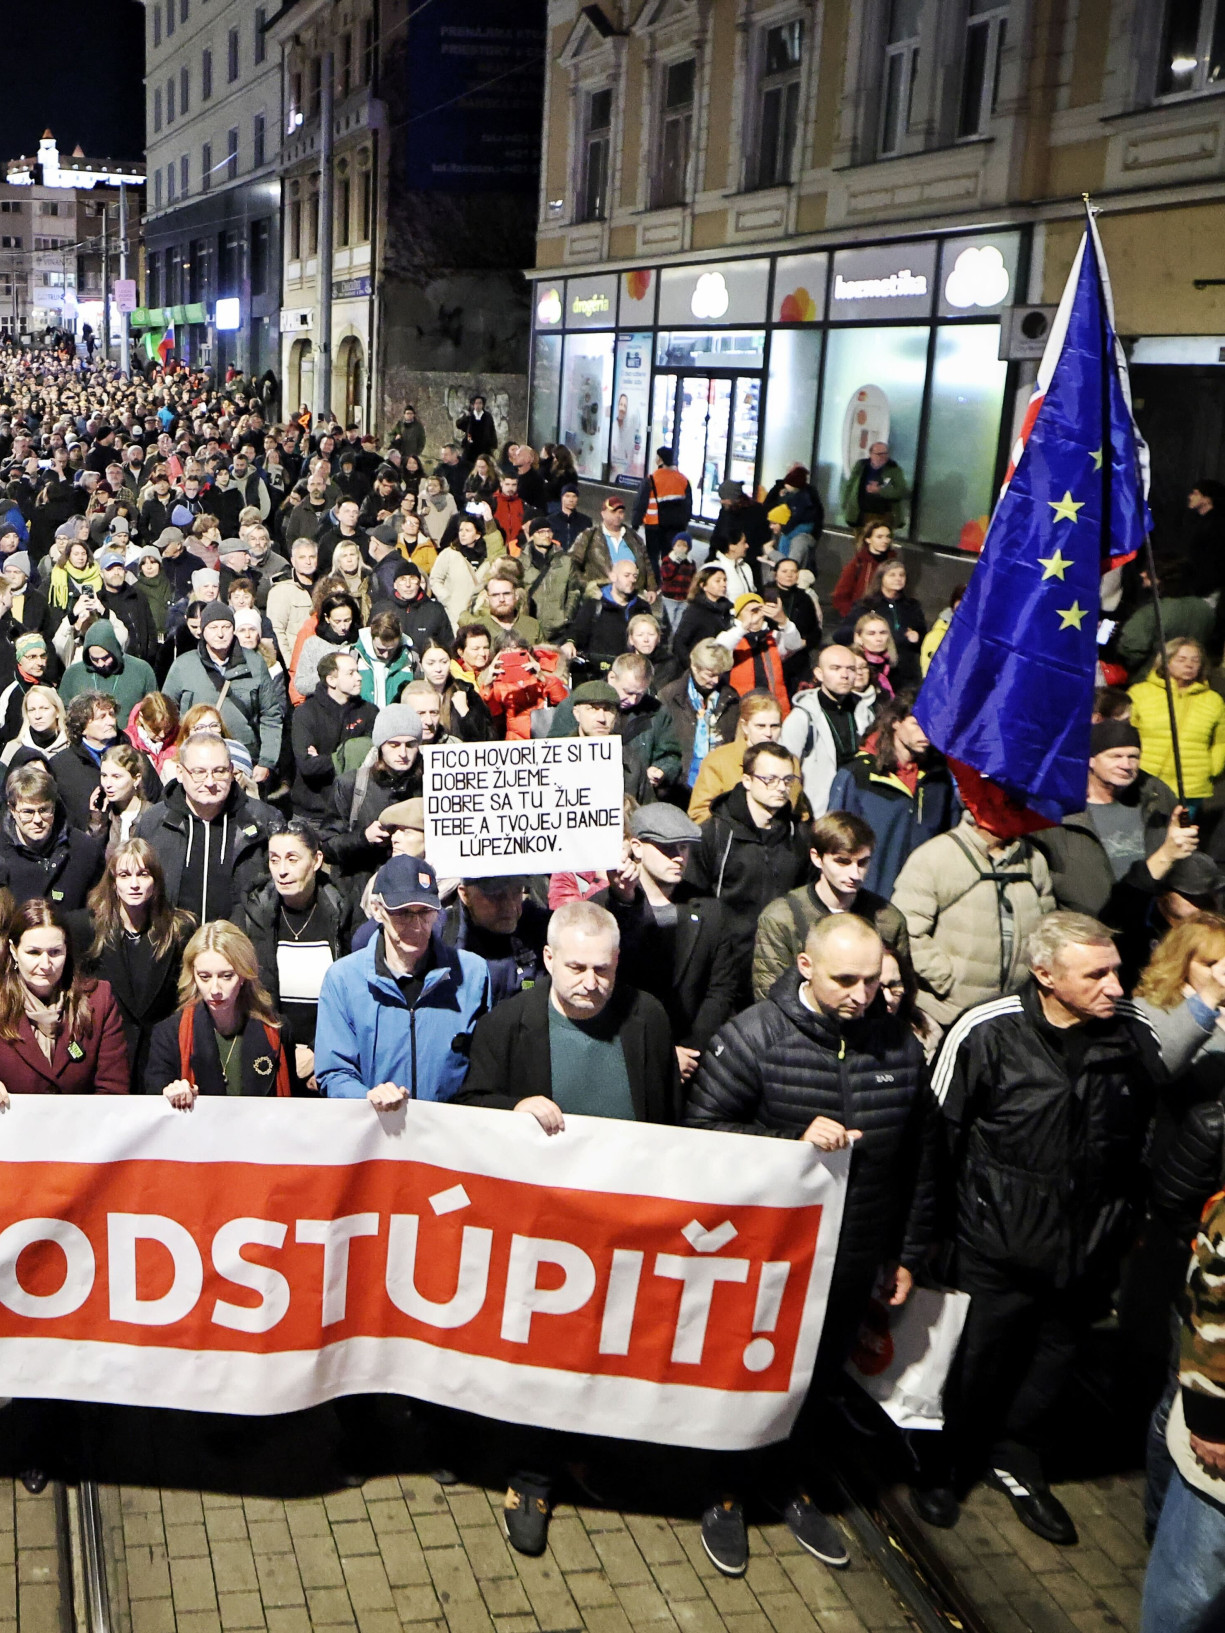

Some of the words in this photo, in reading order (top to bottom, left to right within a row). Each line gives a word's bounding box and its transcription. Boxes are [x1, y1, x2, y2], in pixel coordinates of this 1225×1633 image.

[835, 269, 927, 299] kozmetika
[572, 293, 610, 317] drogéria
[431, 750, 469, 769] FICO
[475, 742, 538, 768] HOVORÍ,
[542, 741, 562, 764] ŽE
[568, 744, 582, 763] SI
[588, 743, 611, 761] TU
[432, 771, 488, 791] DOBRE
[429, 793, 485, 814] DOBRE
[491, 792, 513, 811] SA
[518, 791, 543, 809] TU
[555, 785, 591, 808] ŽIJE
[480, 816, 490, 834] A
[497, 813, 561, 833] TVOJEJ
[567, 808, 620, 829] BANDE
